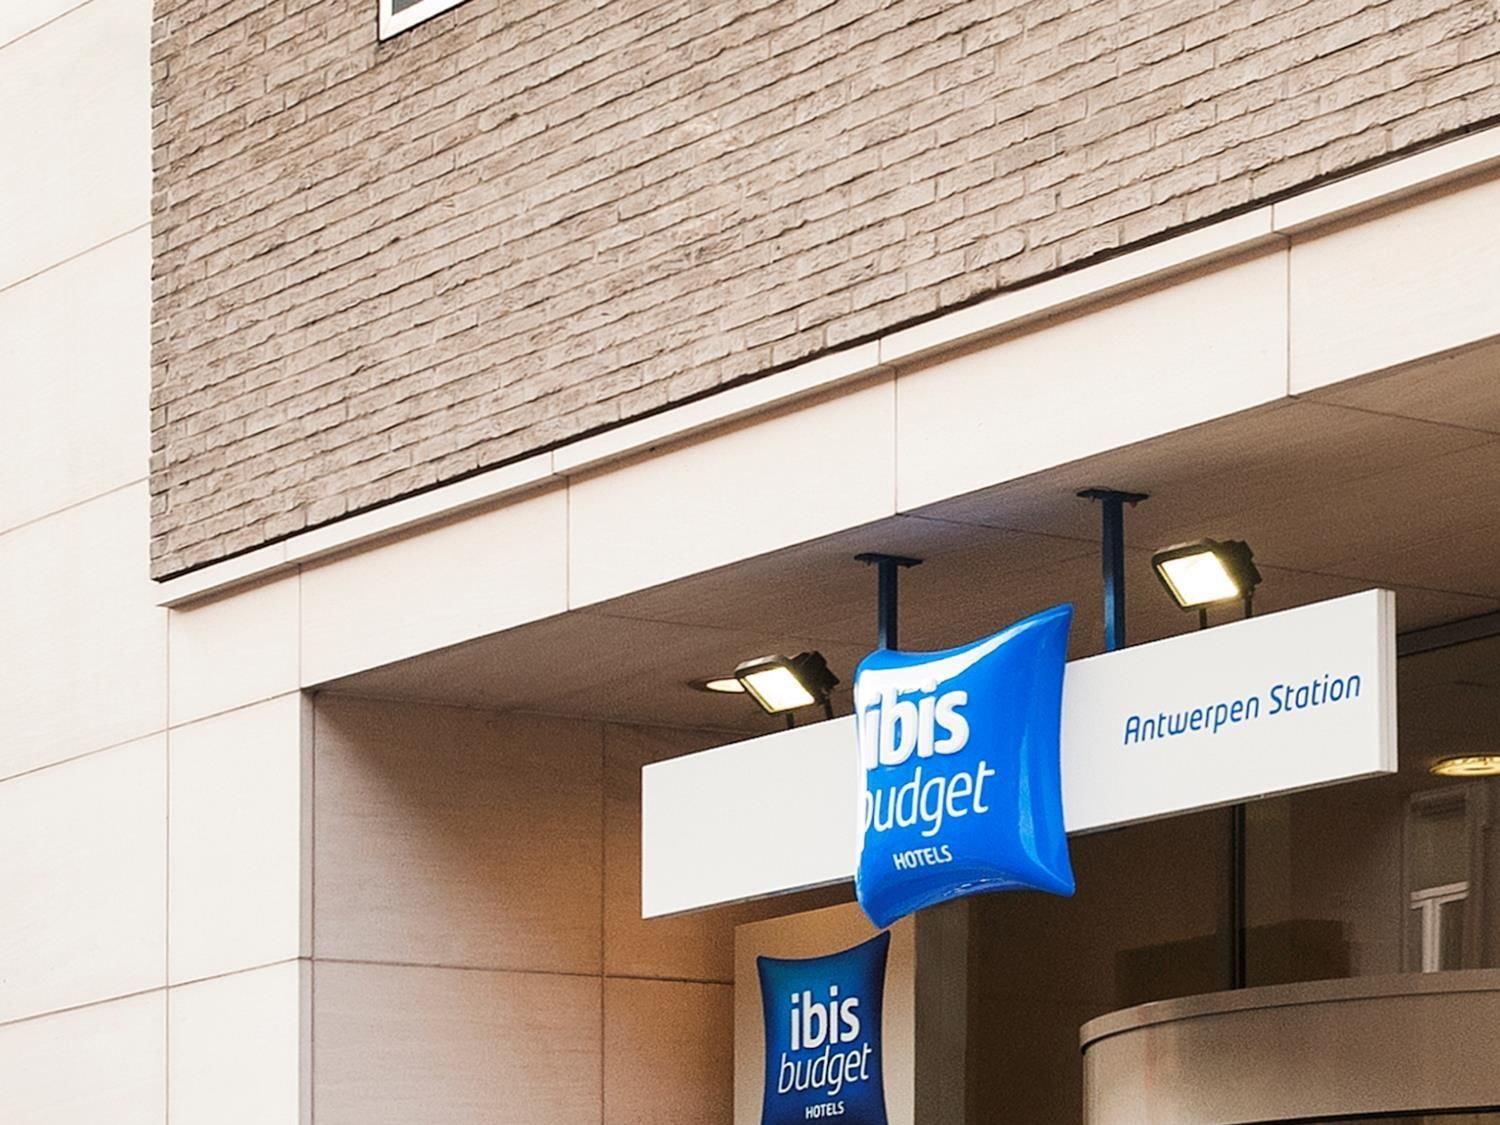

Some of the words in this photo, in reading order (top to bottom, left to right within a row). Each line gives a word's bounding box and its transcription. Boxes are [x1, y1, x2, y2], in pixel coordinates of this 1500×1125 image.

[1124, 696, 1260, 745] Antwerpen
[1269, 673, 1361, 715] Station
[892, 844, 953, 871] HOTELS
[791, 985, 860, 1050] ibis
[778, 1042, 872, 1096] budget
[805, 1101, 845, 1120] HOTELS
